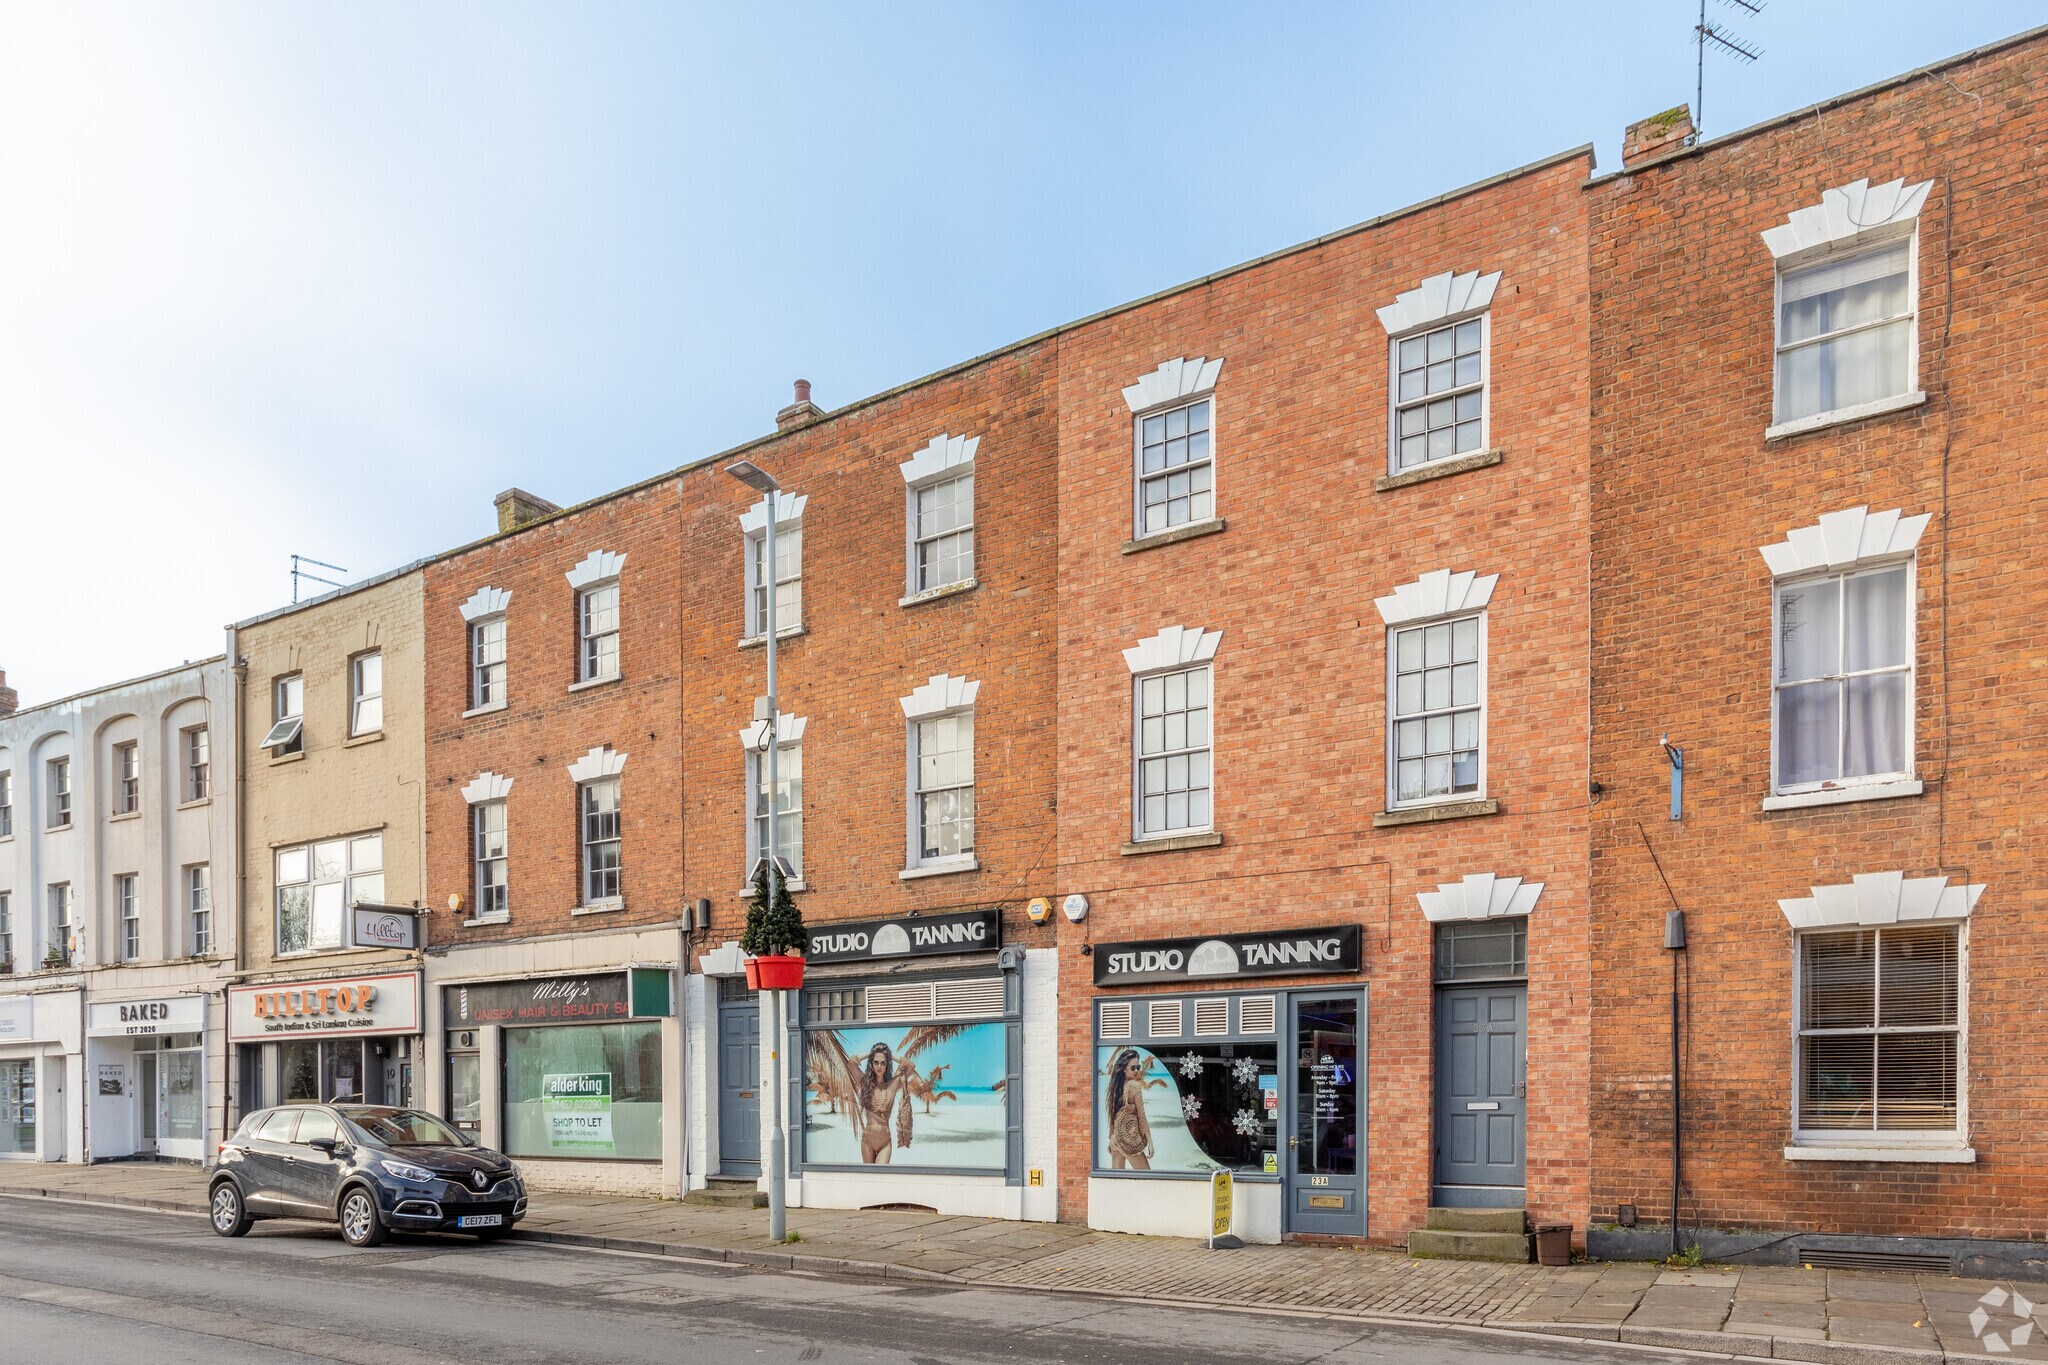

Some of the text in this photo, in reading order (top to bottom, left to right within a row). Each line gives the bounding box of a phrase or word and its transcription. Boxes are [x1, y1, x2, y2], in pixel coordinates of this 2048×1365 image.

[365, 922, 406, 945] Hilltop
[811, 921, 986, 955] STUDIO TANNING
[1108, 939, 1341, 974] STUDIO TANNING
[532, 980, 590, 1004] Milly's
[254, 985, 378, 1018] HILLTOP
[120, 1003, 168, 1021] BAKED
[474, 1009, 513, 1021] UNISEX
[518, 1006, 546, 1018] HAIR
[550, 1005, 559, 1016] &
[562, 1002, 609, 1016] BEAUTY
[140, 1025, 156, 1033] 2020
[264, 1023, 283, 1032] South
[284, 1022, 304, 1031] Indian
[311, 1020, 321, 1029] Sri
[322, 1020, 347, 1029] Lankan
[348, 1018, 373, 1028] Cuisine
[387, 1069, 396, 1079] 19
[551, 1076, 602, 1094] alder king
[553, 1118, 602, 1127] SHOP TO LET
[1031, 1171, 1040, 1185] H
[1312, 1177, 1328, 1185] 23A
[465, 1216, 499, 1226] CE17 ZFL
[1215, 1216, 1230, 1229] OPEN
